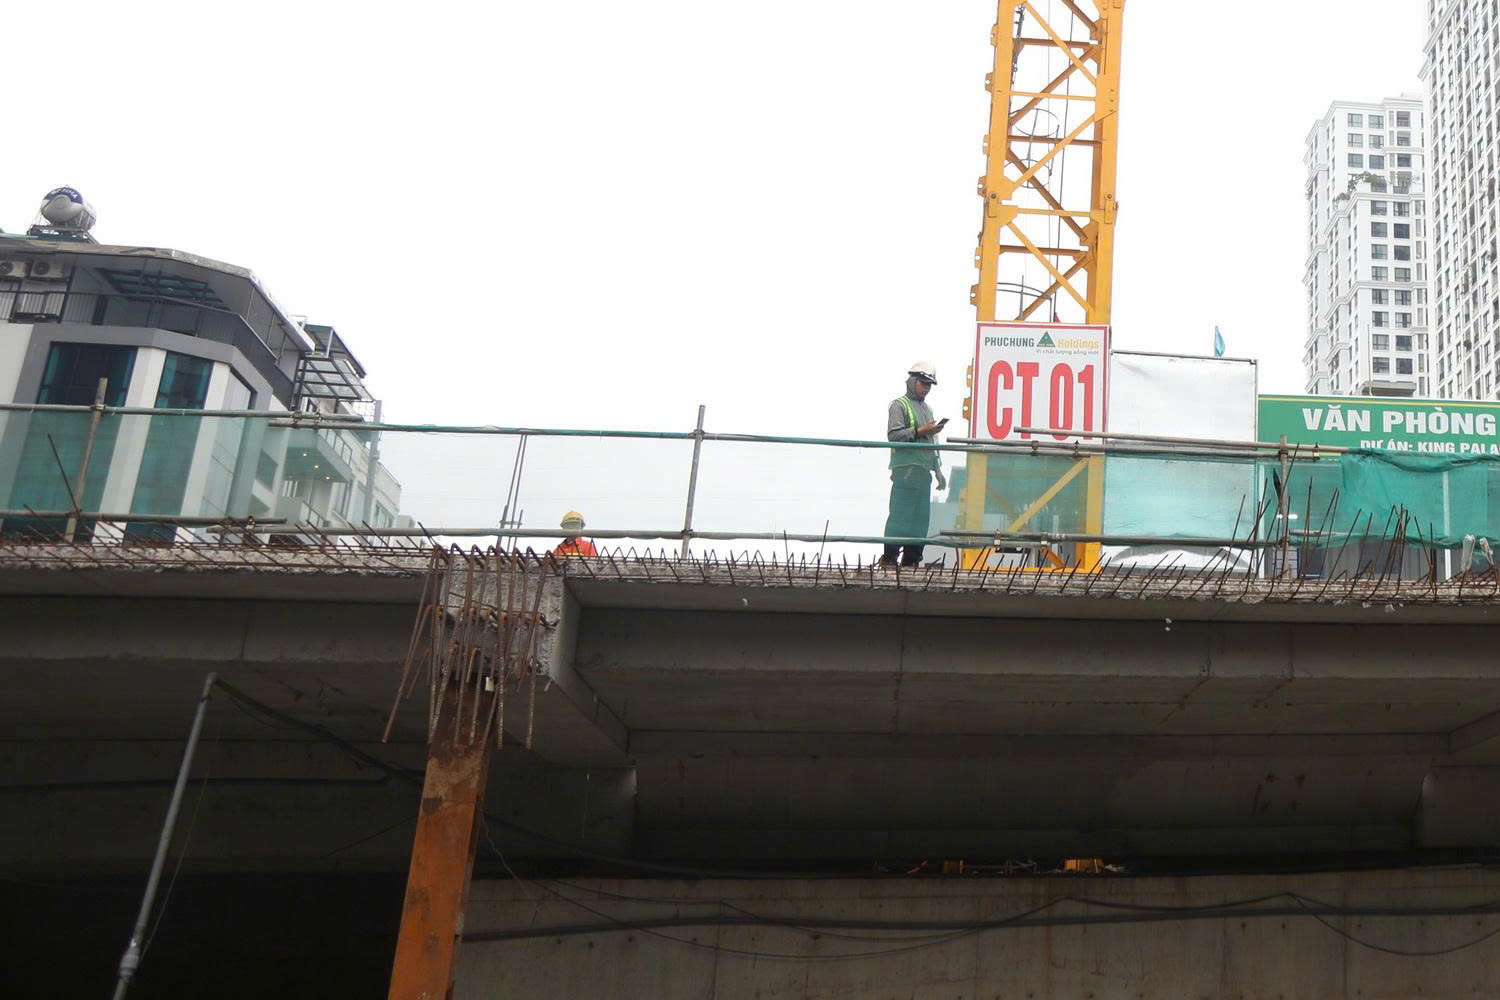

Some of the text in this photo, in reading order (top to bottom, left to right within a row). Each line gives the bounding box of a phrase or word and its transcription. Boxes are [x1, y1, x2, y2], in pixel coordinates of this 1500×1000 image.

[984, 336, 1099, 349] PHUCHUNG Holdings
[986, 360, 1094, 440] CT 01
[1302, 404, 1371, 432] VĂN
[1383, 407, 1497, 436] PHÒNG
[1418, 441, 1455, 453] KING
